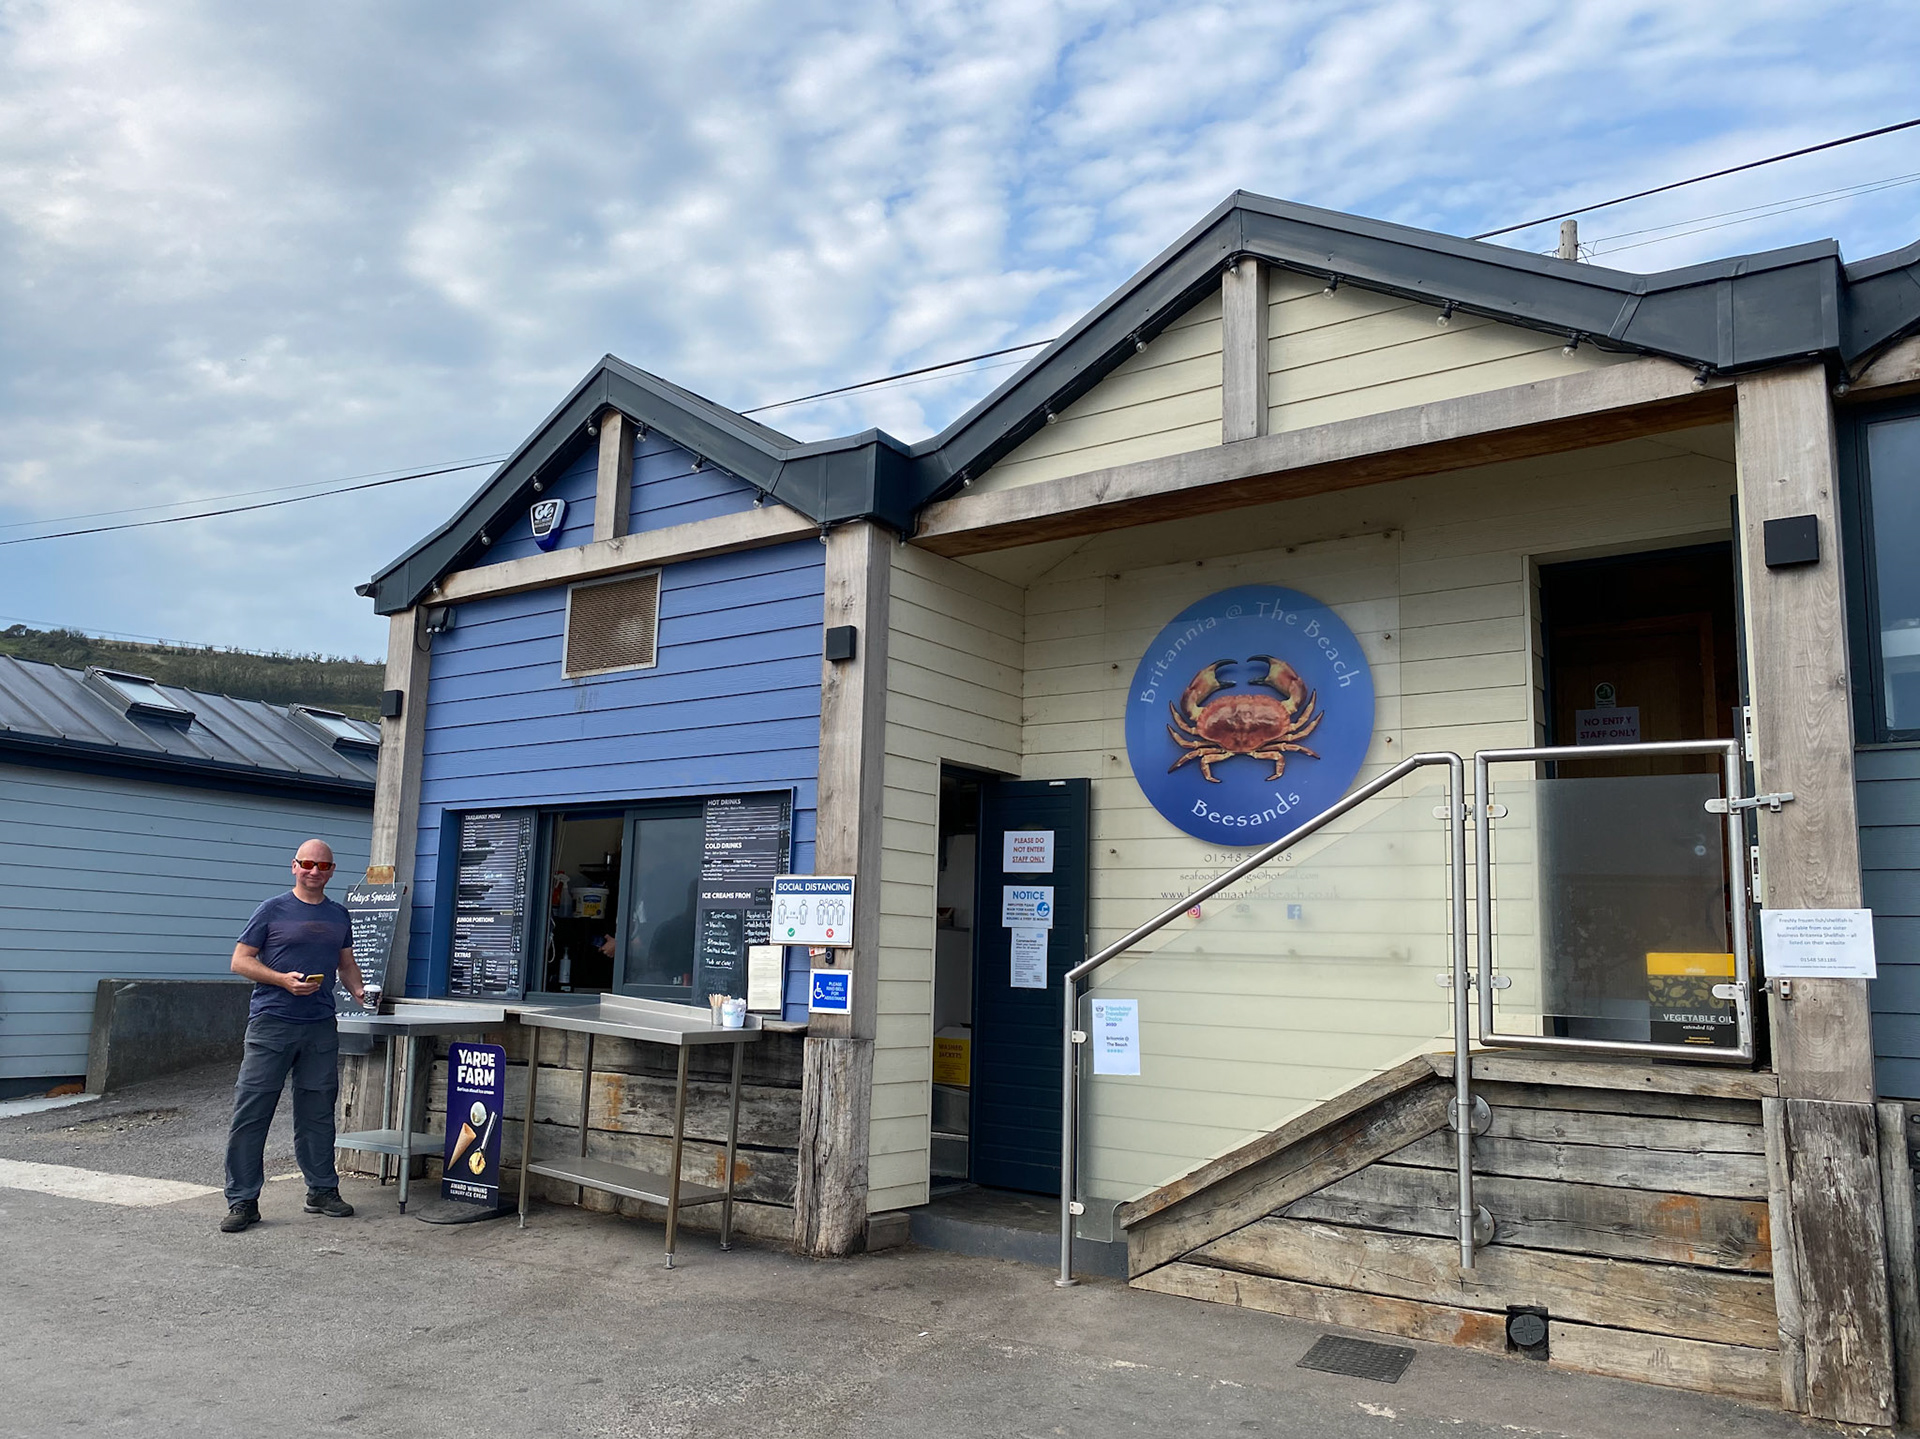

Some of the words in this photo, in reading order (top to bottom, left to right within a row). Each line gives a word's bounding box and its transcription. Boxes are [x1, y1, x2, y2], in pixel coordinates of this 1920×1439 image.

[1141, 617, 1217, 704] Britannia
[1226, 604, 1242, 620] @
[1256, 599, 1297, 625] The
[1304, 619, 1360, 688] Beach
[1602, 716, 1632, 725] ENTRY
[1580, 730, 1606, 739] STAFF
[1609, 729, 1636, 738] ONLY
[1191, 791, 1300, 827] Beesands
[705, 842, 721, 850] COLD
[1204, 853, 1242, 865] 01548
[778, 883, 804, 891] SOCIAL
[805, 882, 850, 891] DISTANCING
[347, 892, 370, 905] Todays
[371, 891, 397, 904] Specials
[1012, 890, 1045, 900] NOTICE
[1663, 1013, 1717, 1023] VEGETABLE
[1718, 1015, 1735, 1024] OIL
[458, 1049, 496, 1068] YARDE
[457, 1065, 495, 1087] FARM
[450, 1182, 467, 1191] AWARD
[467, 1185, 488, 1195] WINNING
[472, 1192, 488, 1200] CREAM
